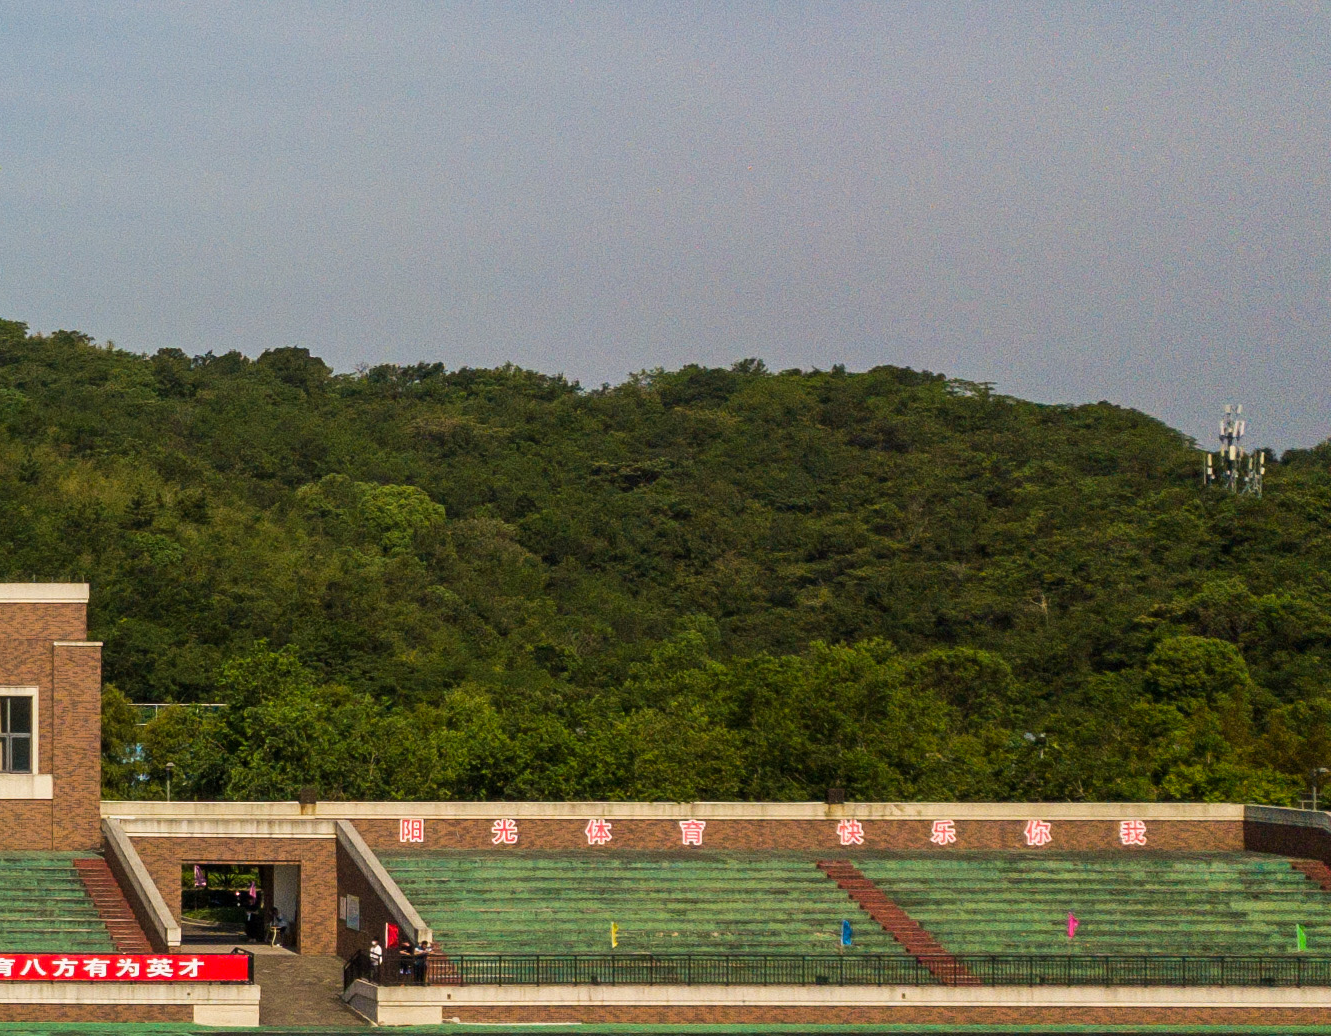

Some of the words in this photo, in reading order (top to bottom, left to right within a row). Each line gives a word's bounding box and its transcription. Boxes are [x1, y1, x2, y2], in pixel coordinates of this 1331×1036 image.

[399, 818, 705, 846] 阳光体育
[837, 819, 1146, 846] 快乐你我
